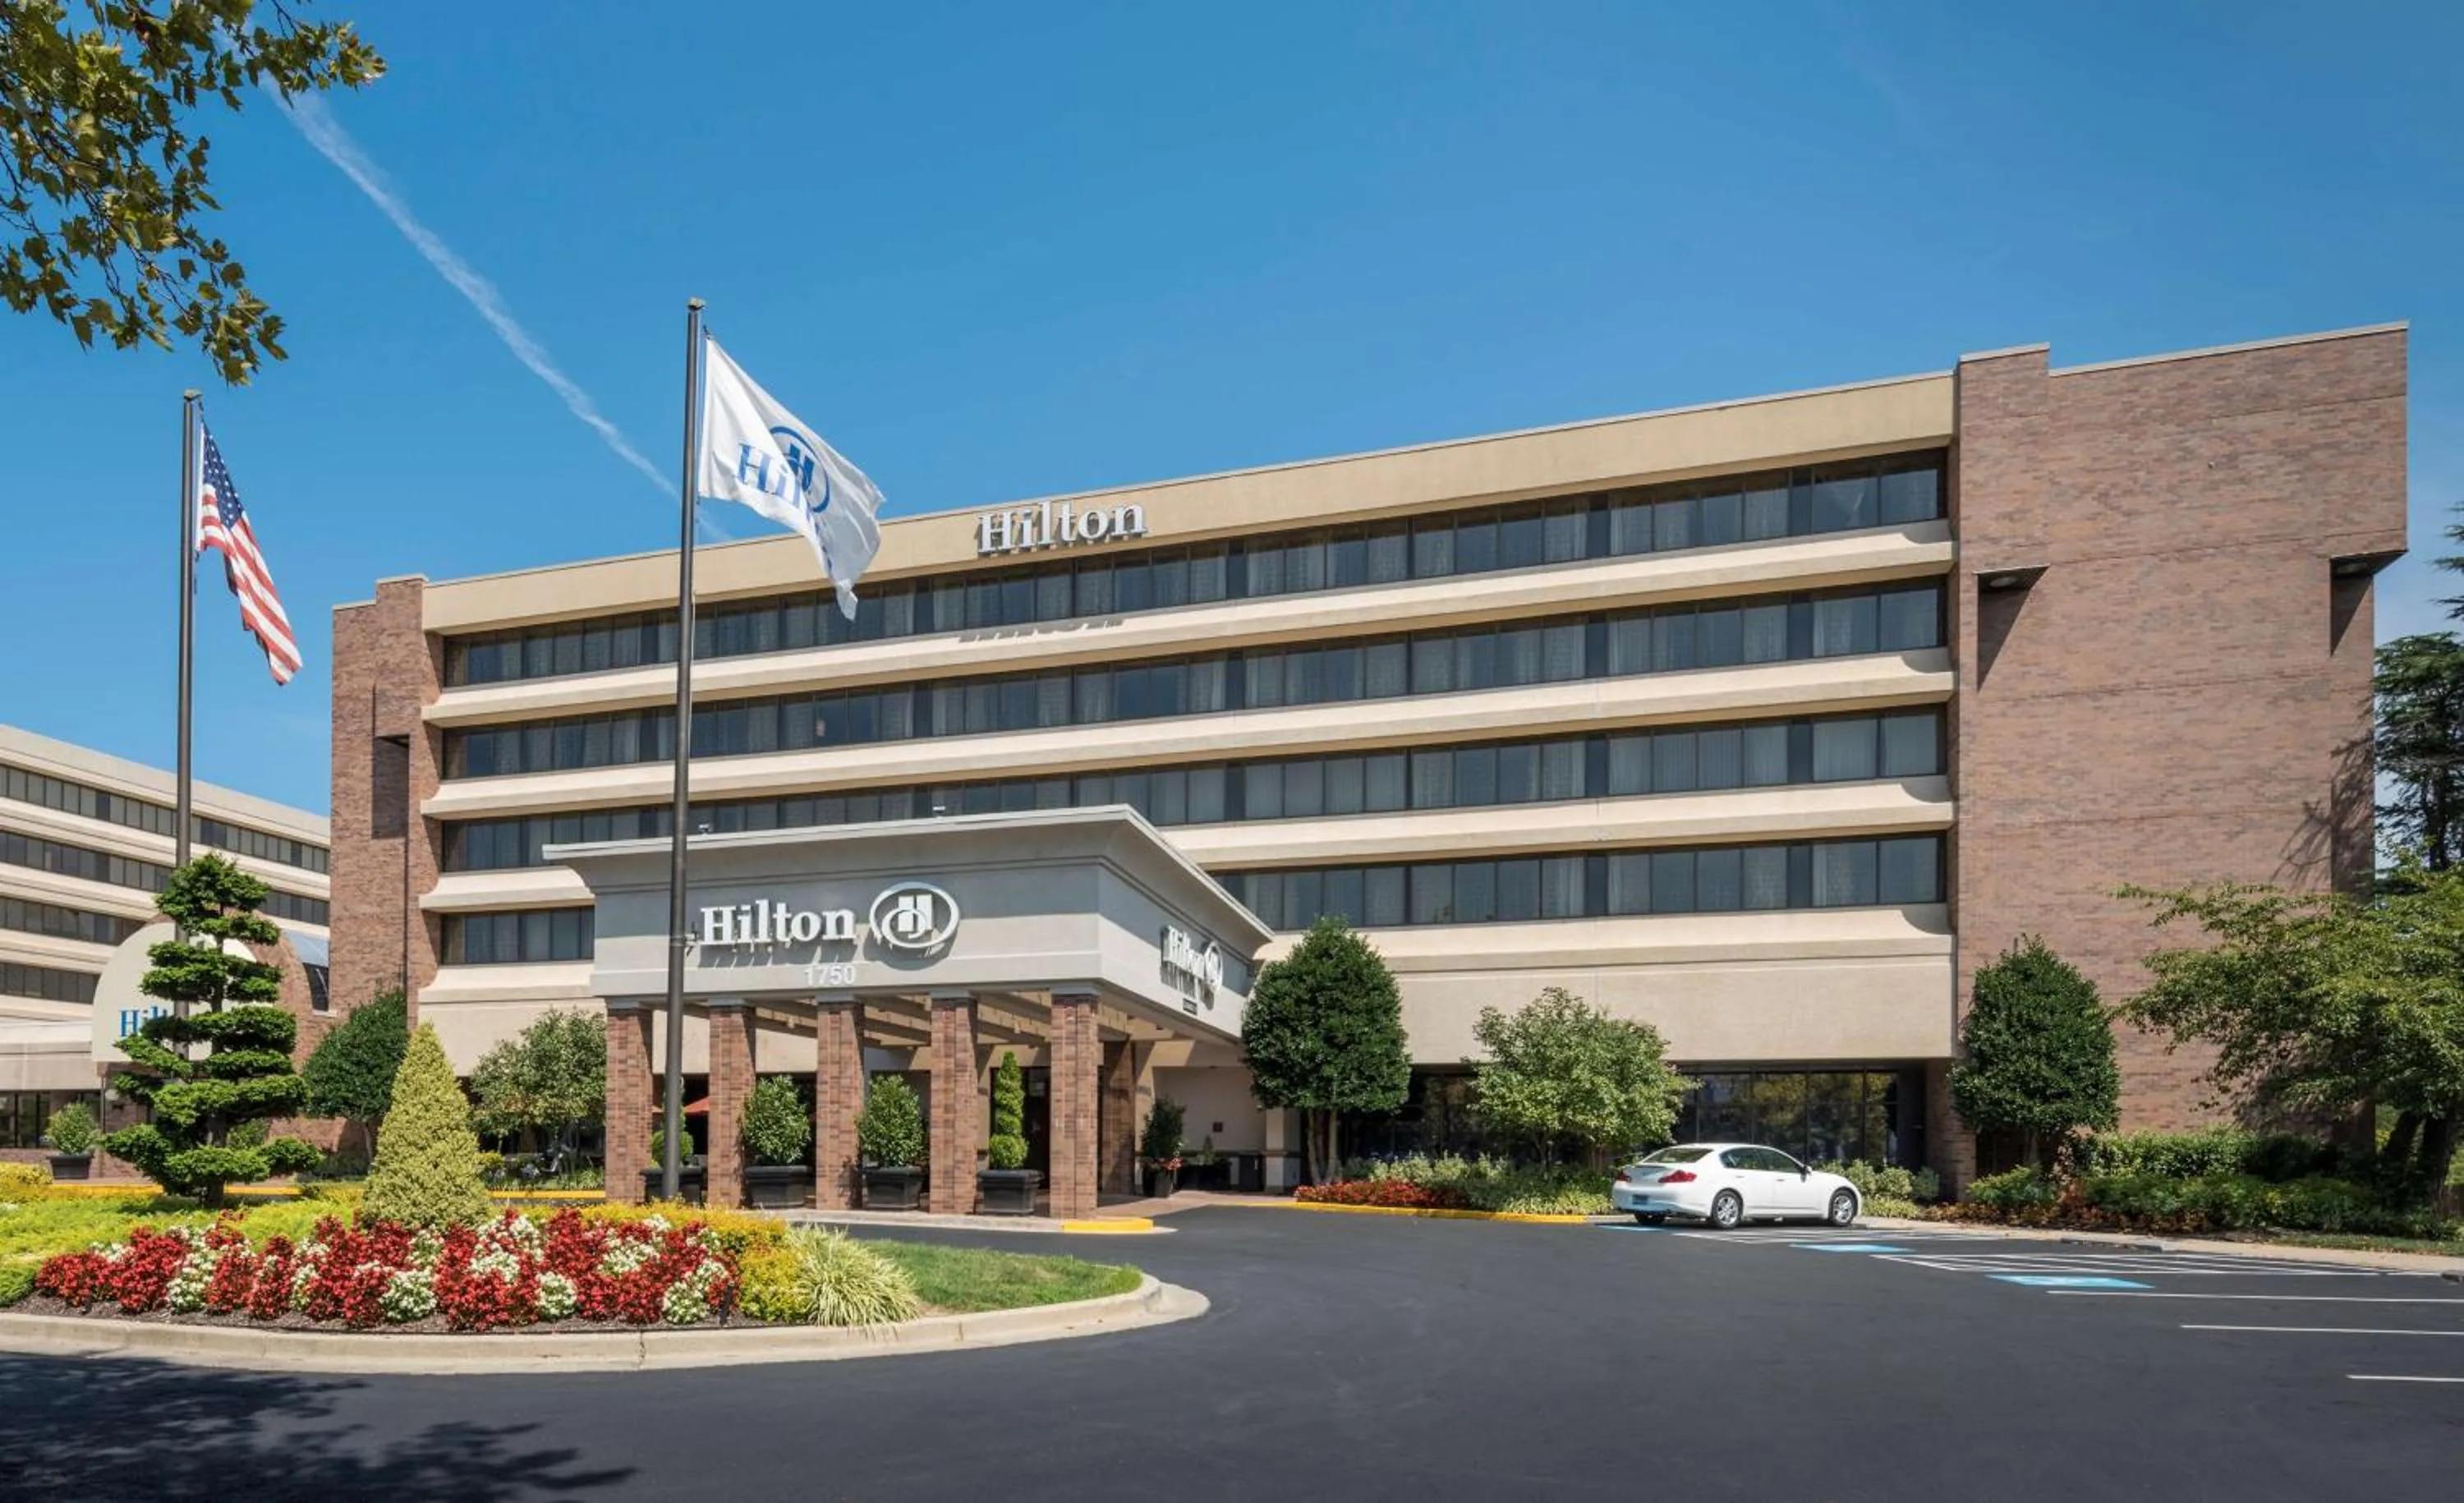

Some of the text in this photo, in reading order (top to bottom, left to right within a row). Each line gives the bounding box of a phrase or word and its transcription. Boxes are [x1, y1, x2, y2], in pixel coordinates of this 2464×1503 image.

[978, 500, 1147, 553] Hilton
[699, 899, 857, 945] Hilton
[804, 965, 856, 986] 1750
